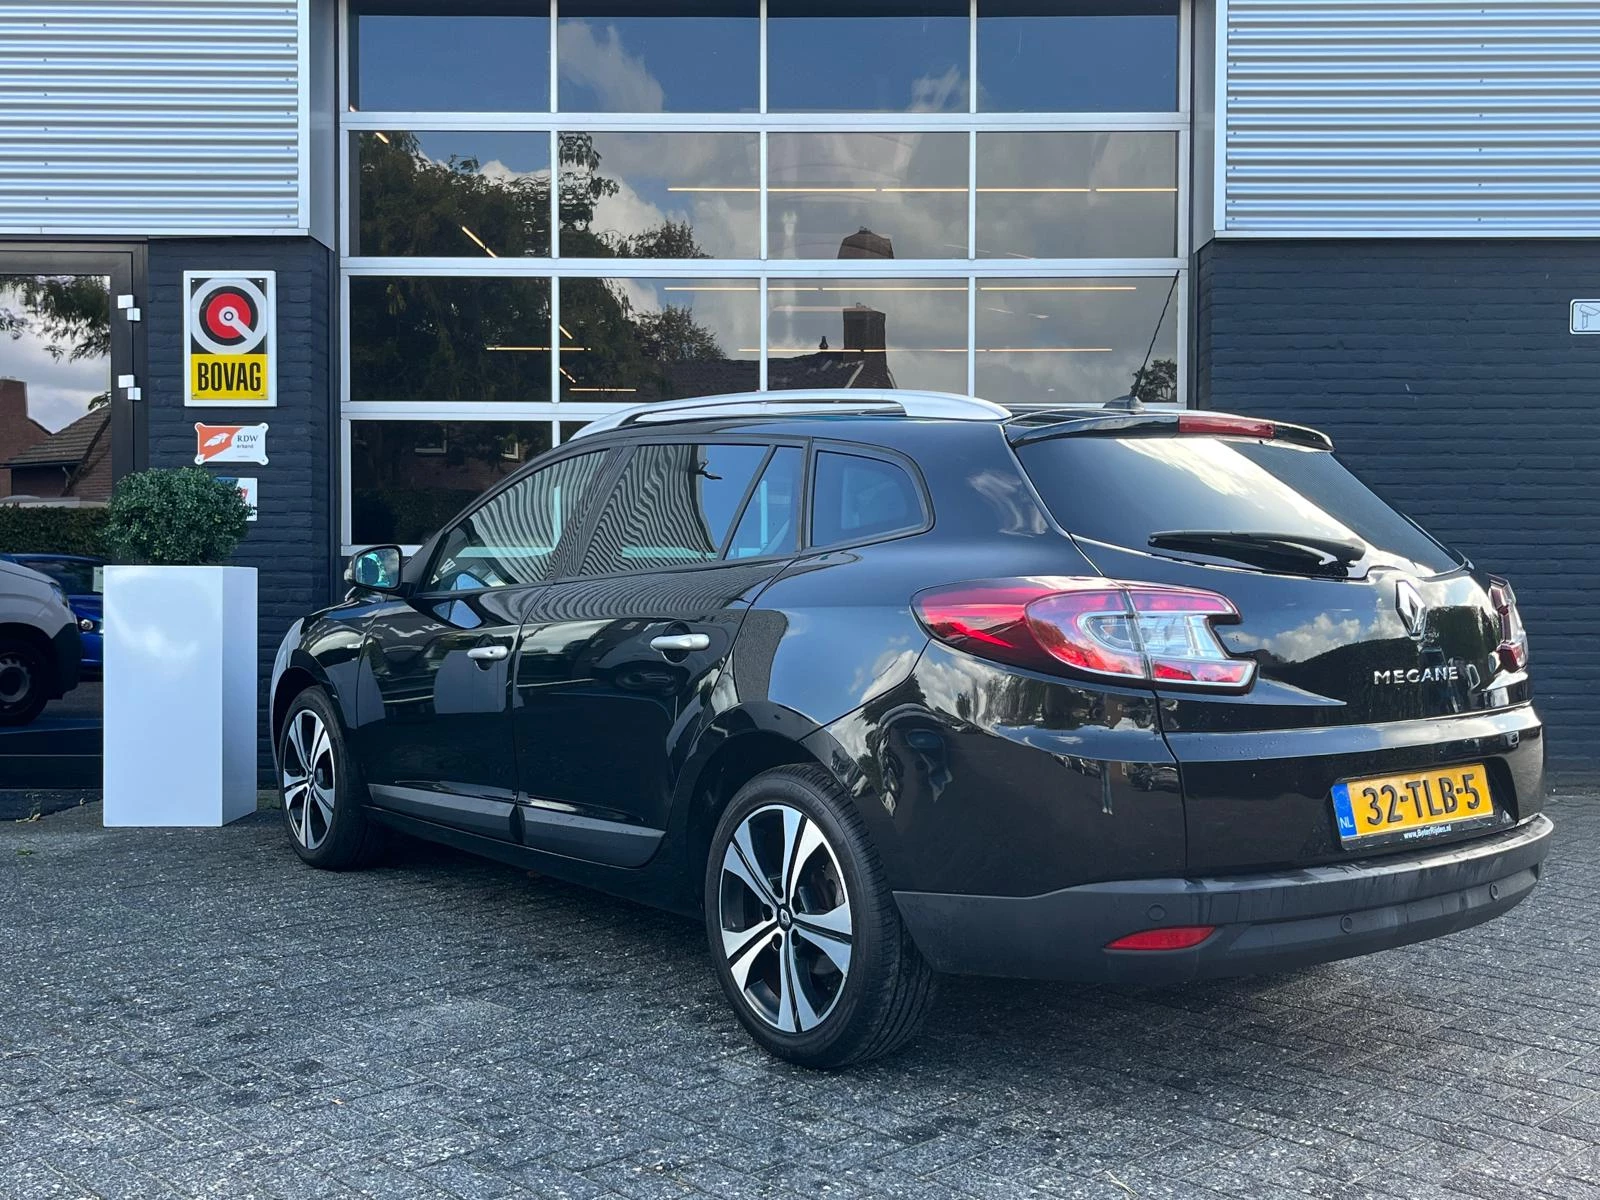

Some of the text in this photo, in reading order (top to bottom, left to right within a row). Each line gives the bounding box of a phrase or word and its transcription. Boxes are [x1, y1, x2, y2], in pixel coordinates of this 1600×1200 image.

[197, 361, 262, 392] BOVAG
[237, 434, 258, 442] RDW
[1373, 666, 1459, 685] MEGANE
[1362, 773, 1481, 826] 32-TLB-5
[1339, 816, 1354, 829] NL
